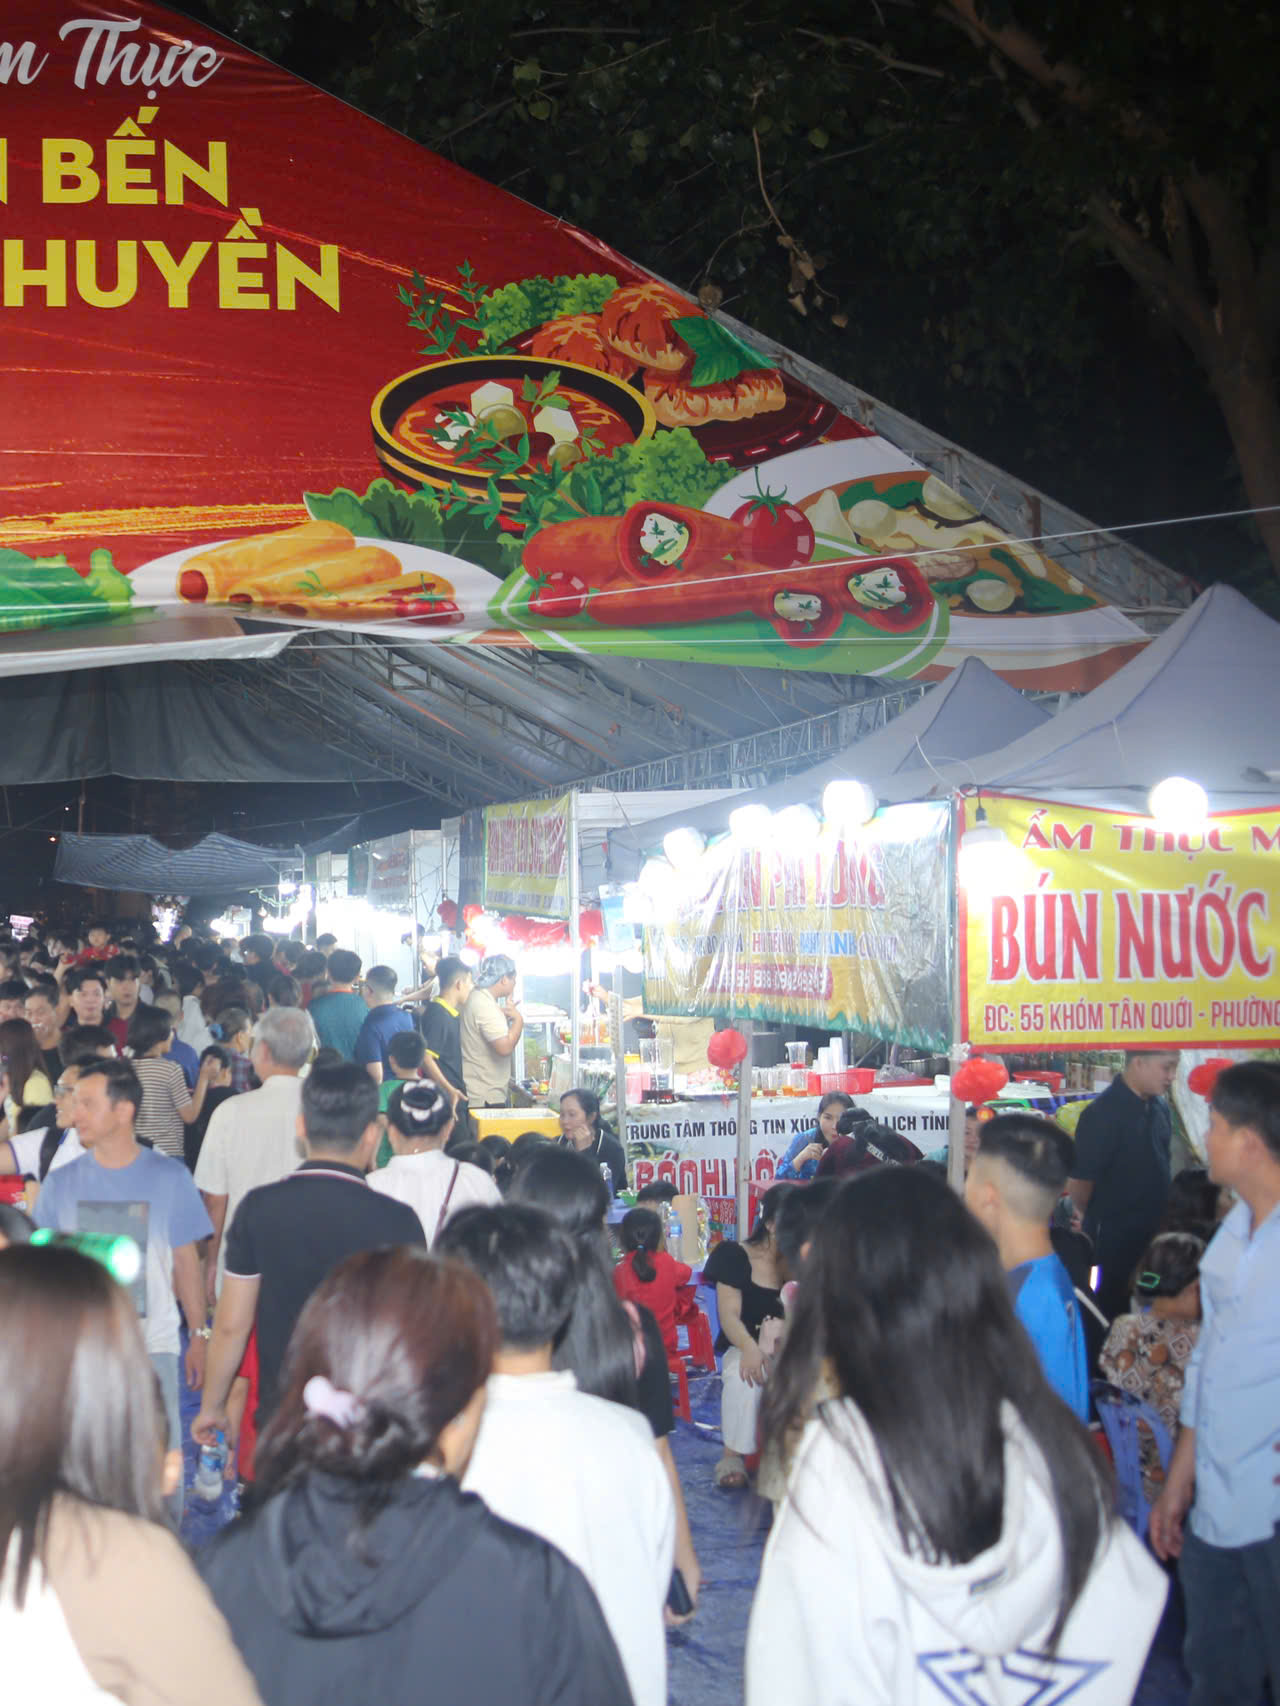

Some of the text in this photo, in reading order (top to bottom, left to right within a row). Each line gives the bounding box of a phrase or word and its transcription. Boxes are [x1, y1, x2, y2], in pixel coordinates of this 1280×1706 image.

[58, 17, 224, 100] Thực
[41, 106, 228, 207] BẾN
[1023, 808, 1093, 851] ẨM
[990, 872, 1271, 981] BÚN NƯỚC
[984, 1004, 1015, 1032] ĐC:
[1020, 1004, 1044, 1032] 55
[1049, 998, 1104, 1032] KHÓM
[1109, 997, 1145, 1031] TÂN
[1151, 995, 1193, 1030] QUỚI
[674, 1118, 706, 1138] TÂM
[709, 1116, 758, 1137] THÔG
[762, 1117, 786, 1134] TIN
